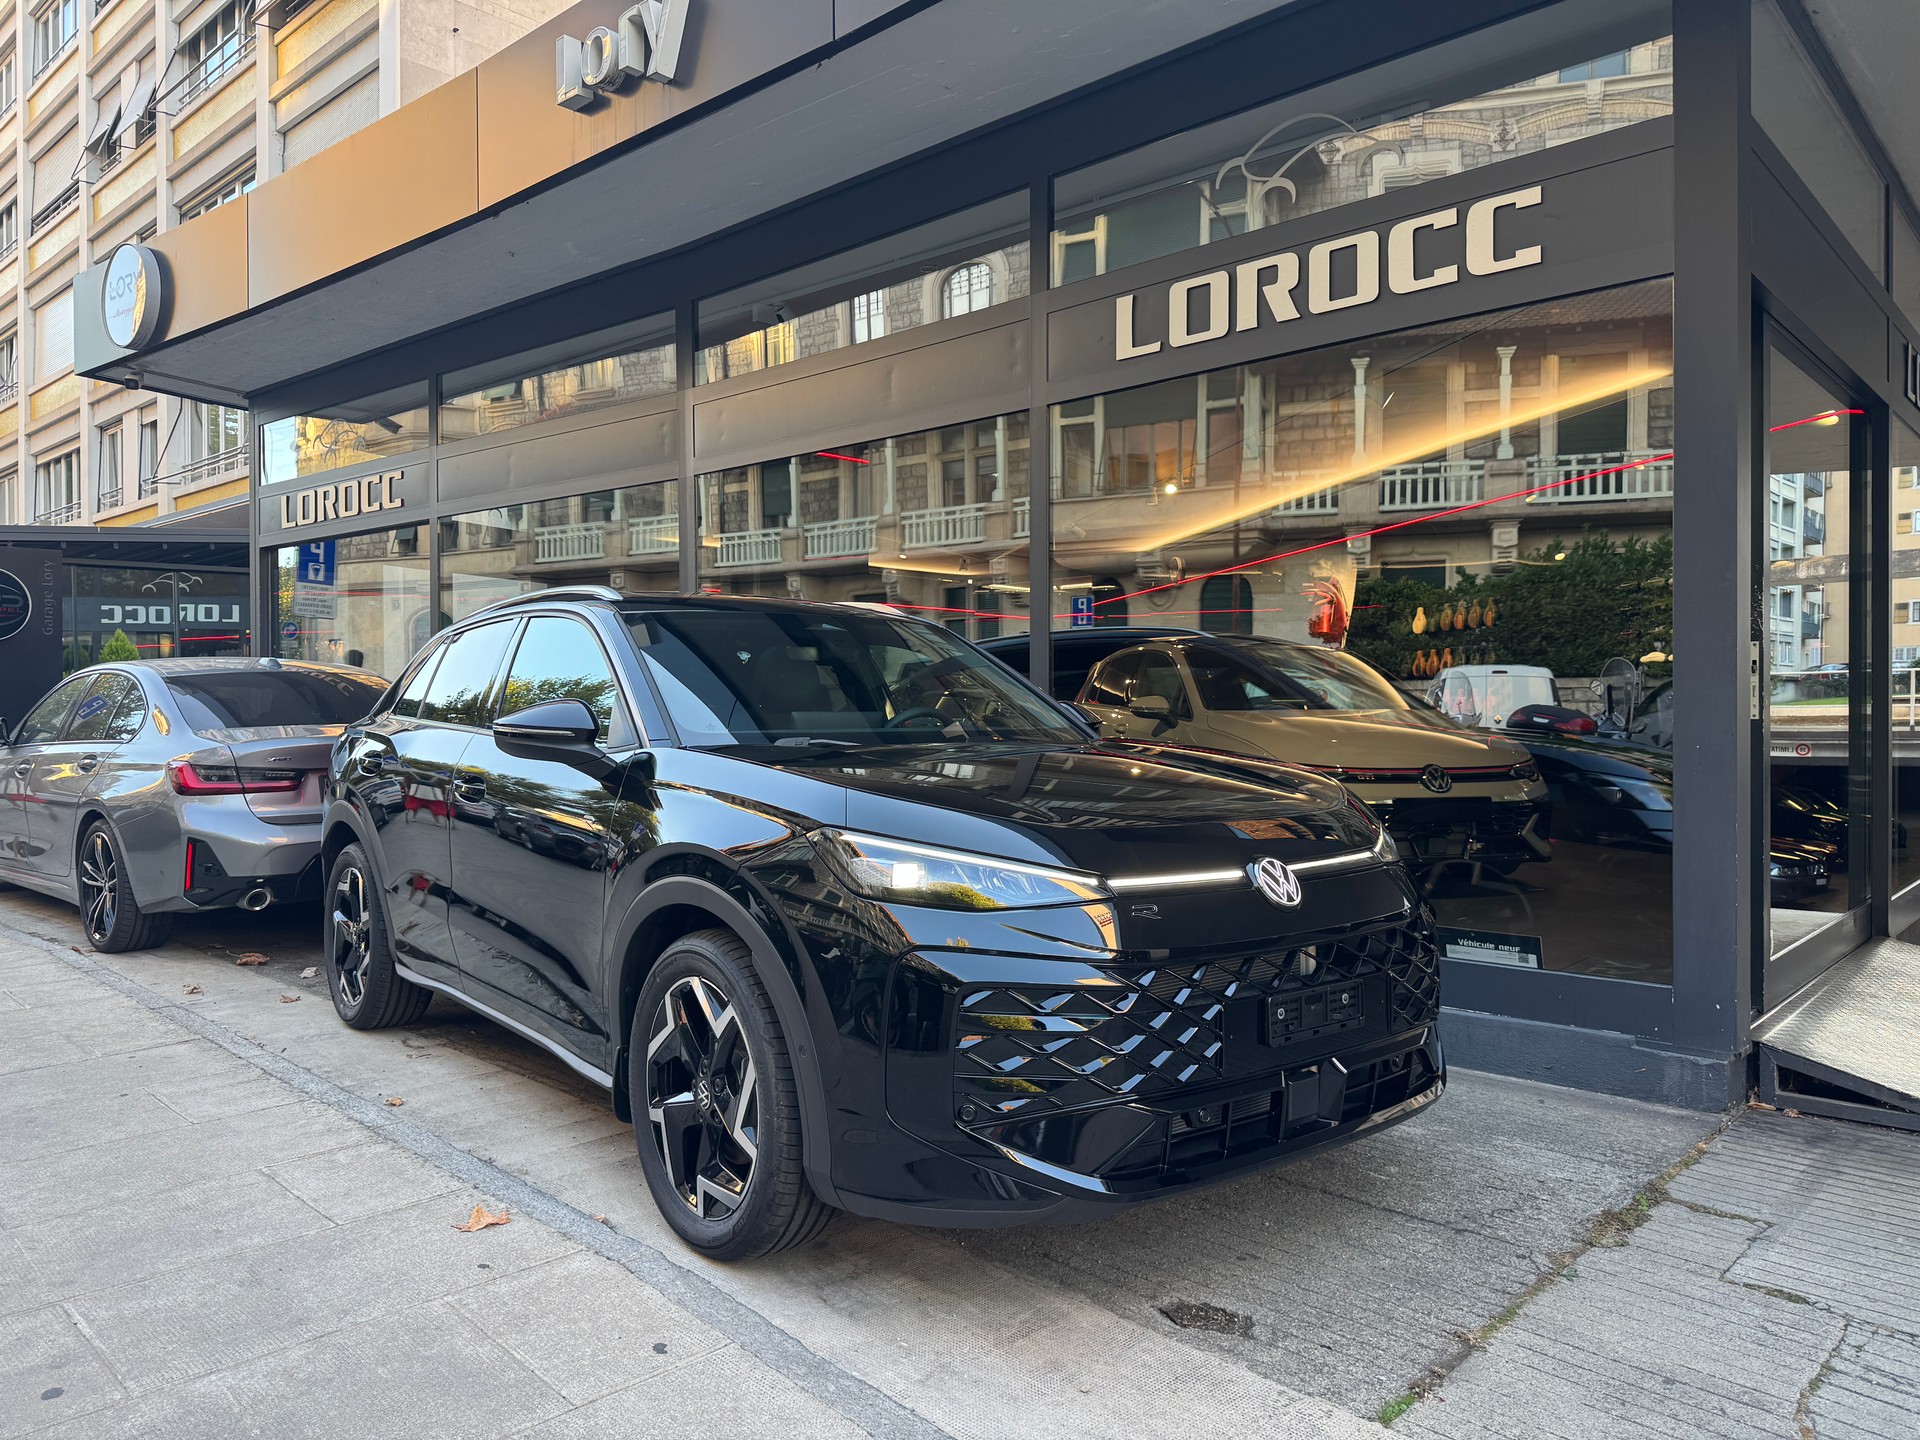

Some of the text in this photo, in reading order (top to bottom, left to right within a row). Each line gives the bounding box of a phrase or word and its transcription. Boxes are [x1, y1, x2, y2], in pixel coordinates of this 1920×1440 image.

[1115, 185, 1543, 361] LOROCC
[281, 470, 403, 529] LOROCC
[42, 559, 56, 635] Garage Lory
[1457, 938, 1521, 952] Véhicule neuf
